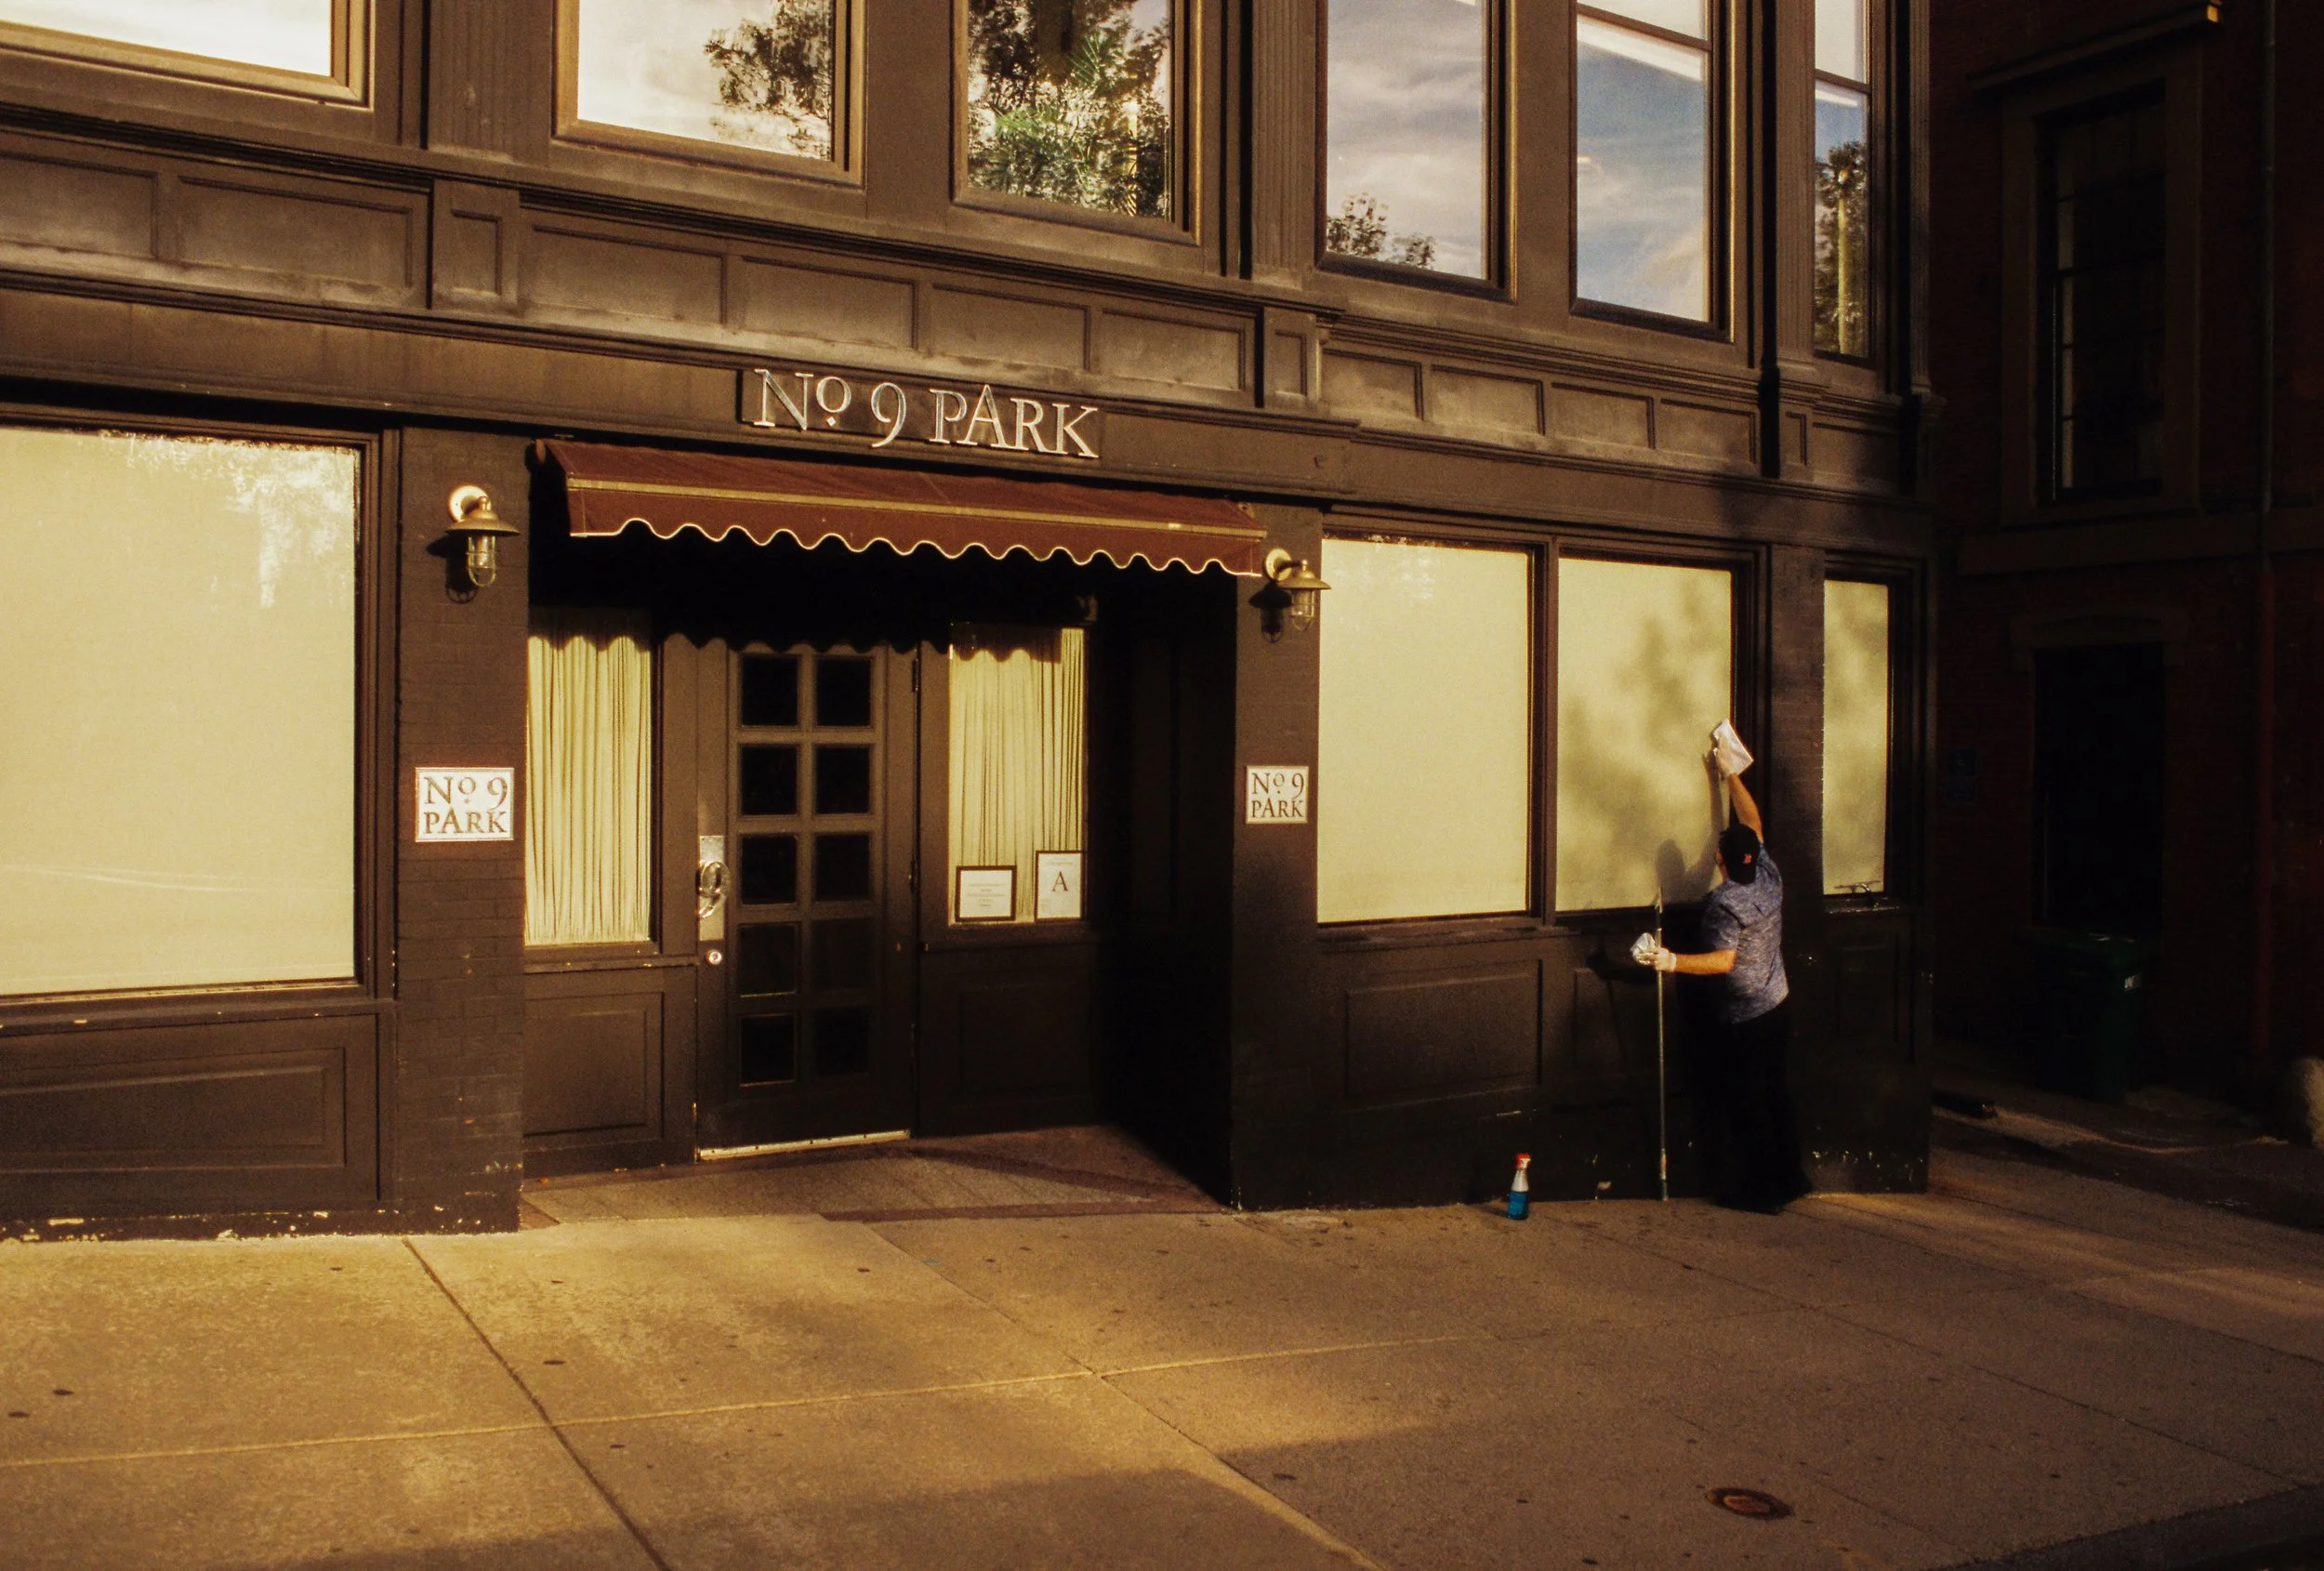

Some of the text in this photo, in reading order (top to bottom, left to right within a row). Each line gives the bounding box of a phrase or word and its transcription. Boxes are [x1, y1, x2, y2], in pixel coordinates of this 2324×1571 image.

[869, 381, 907, 448] 9
[929, 383, 1101, 459] PARK
[486, 775, 508, 812] 9
[1291, 772, 1305, 800] 9
[423, 806, 508, 834] PARK
[1251, 797, 1304, 818] PARK
[1051, 870, 1069, 892] A
